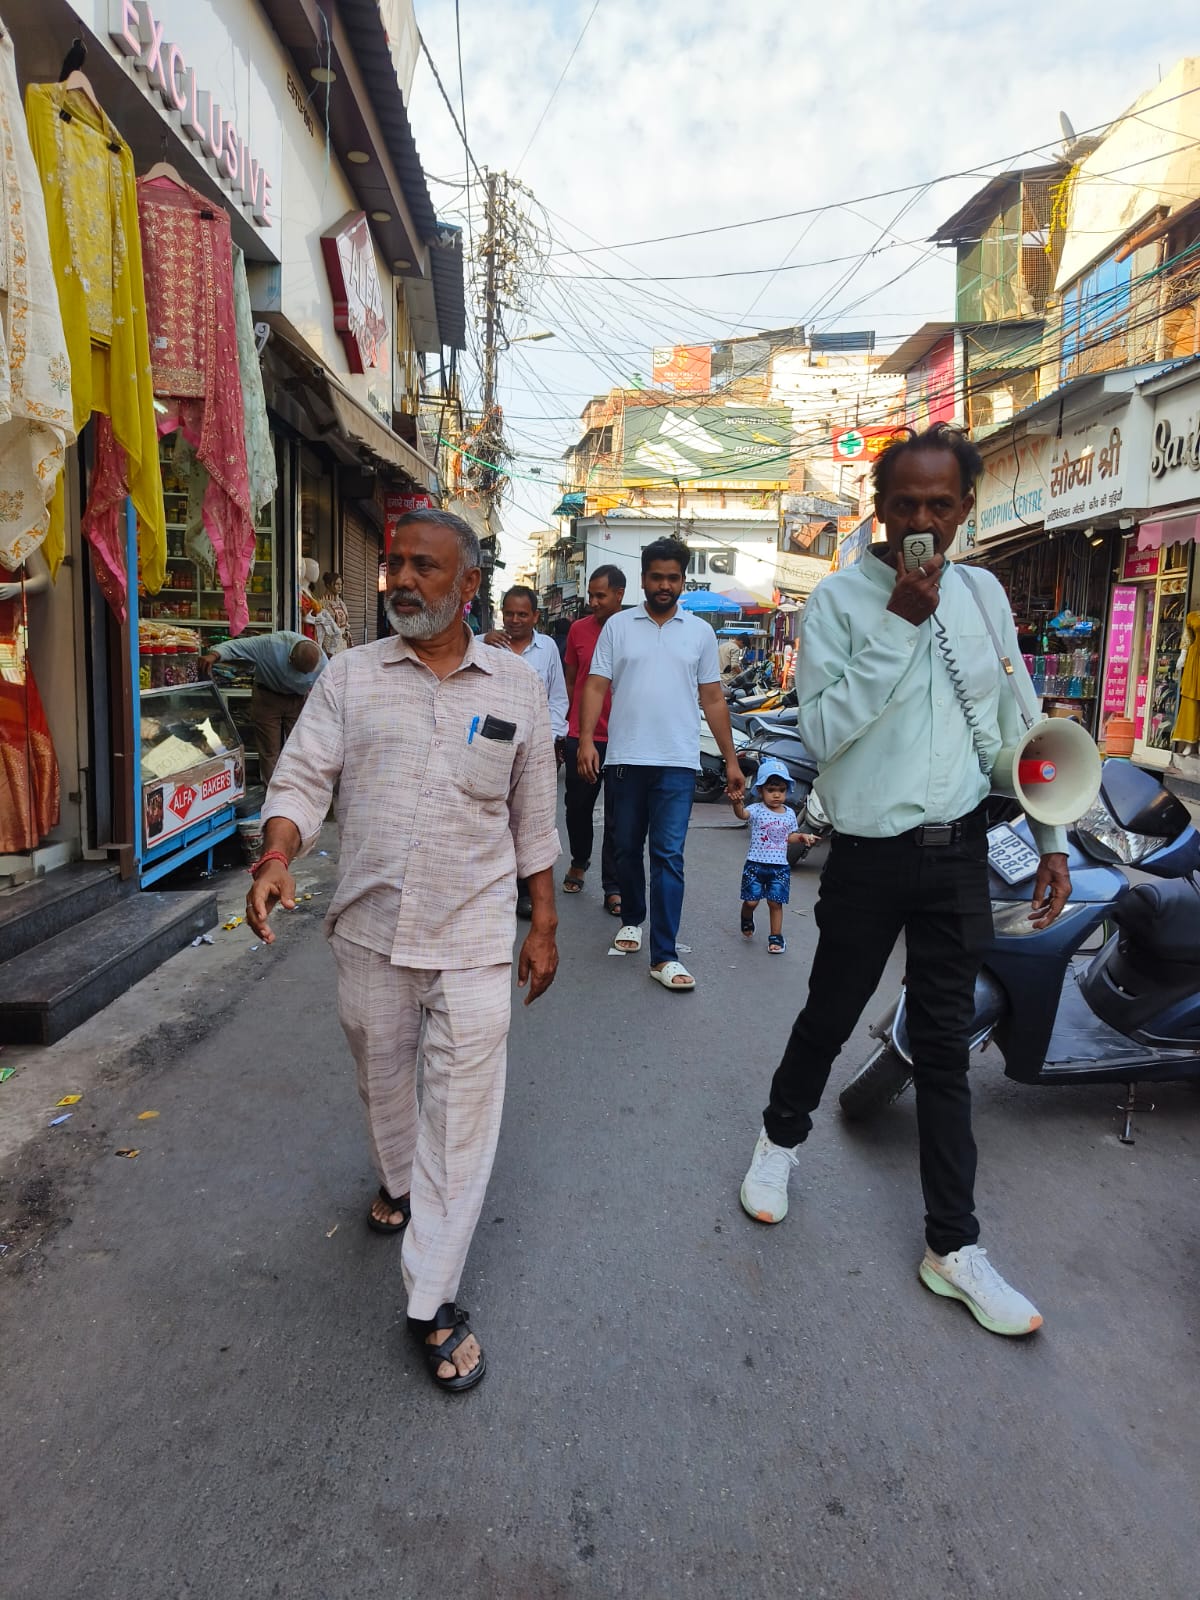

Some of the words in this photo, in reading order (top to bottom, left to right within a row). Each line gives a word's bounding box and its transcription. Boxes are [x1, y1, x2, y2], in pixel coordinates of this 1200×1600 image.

[118, 0, 272, 227] EXCLUSIVE
[1050, 449, 1095, 498] सौम्या
[1098, 427, 1122, 481] श्री
[721, 480, 758, 489] PALACE
[980, 499, 1013, 531] SHOPPING
[1014, 488, 1043, 518] CENTRE
[173, 789, 193, 811] ALFA
[202, 771, 231, 798] BAKER'S
[1000, 835, 1038, 868] UP15C
